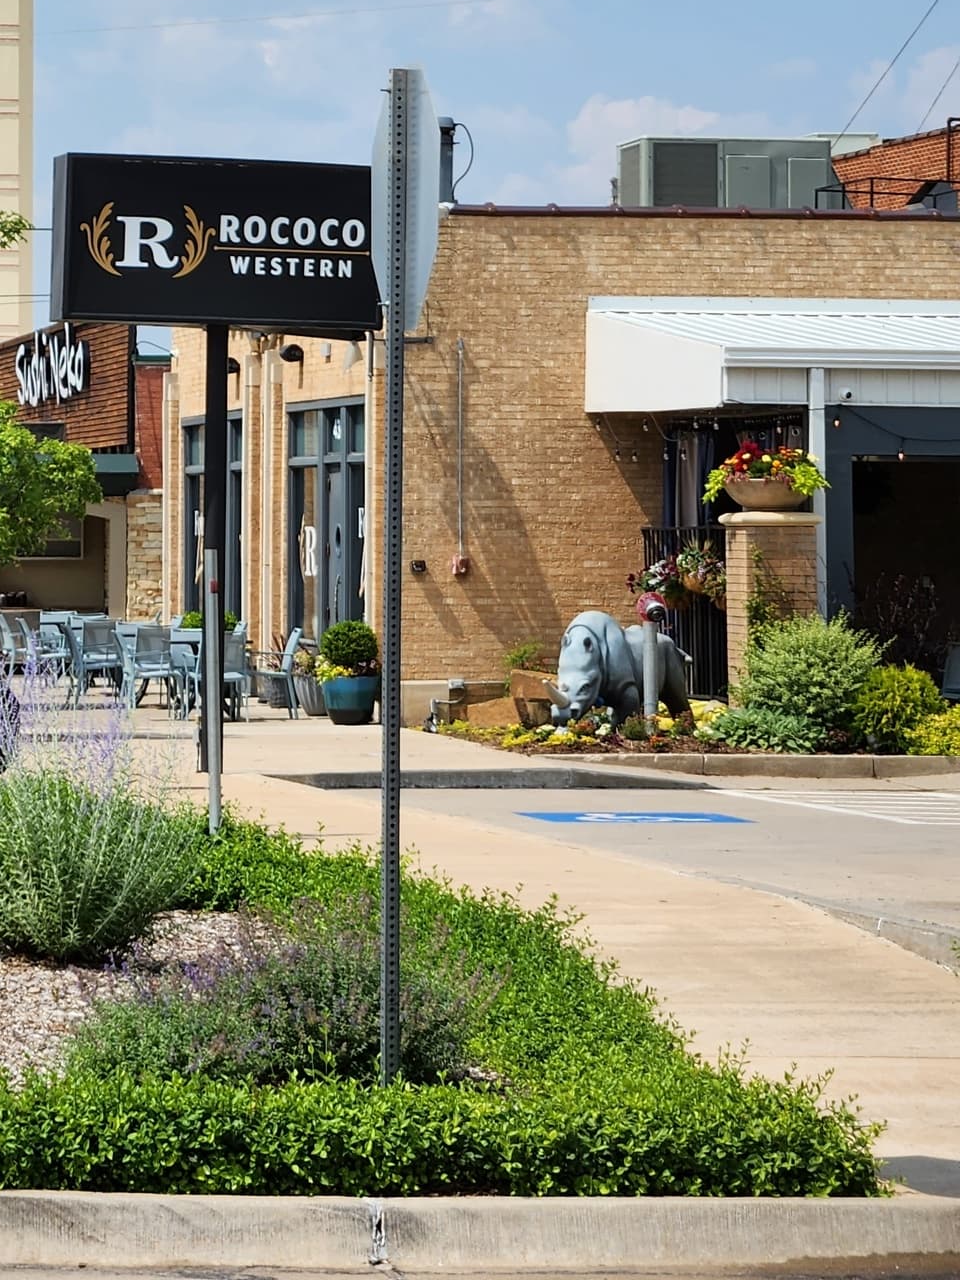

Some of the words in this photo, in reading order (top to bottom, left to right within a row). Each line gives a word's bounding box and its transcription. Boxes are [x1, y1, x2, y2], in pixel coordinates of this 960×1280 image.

[115, 215, 179, 269] R
[219, 214, 367, 248] ROCOCO
[230, 255, 353, 279] WESTERN
[15, 330, 49, 408] Sushi
[48, 321, 84, 407] Neko
